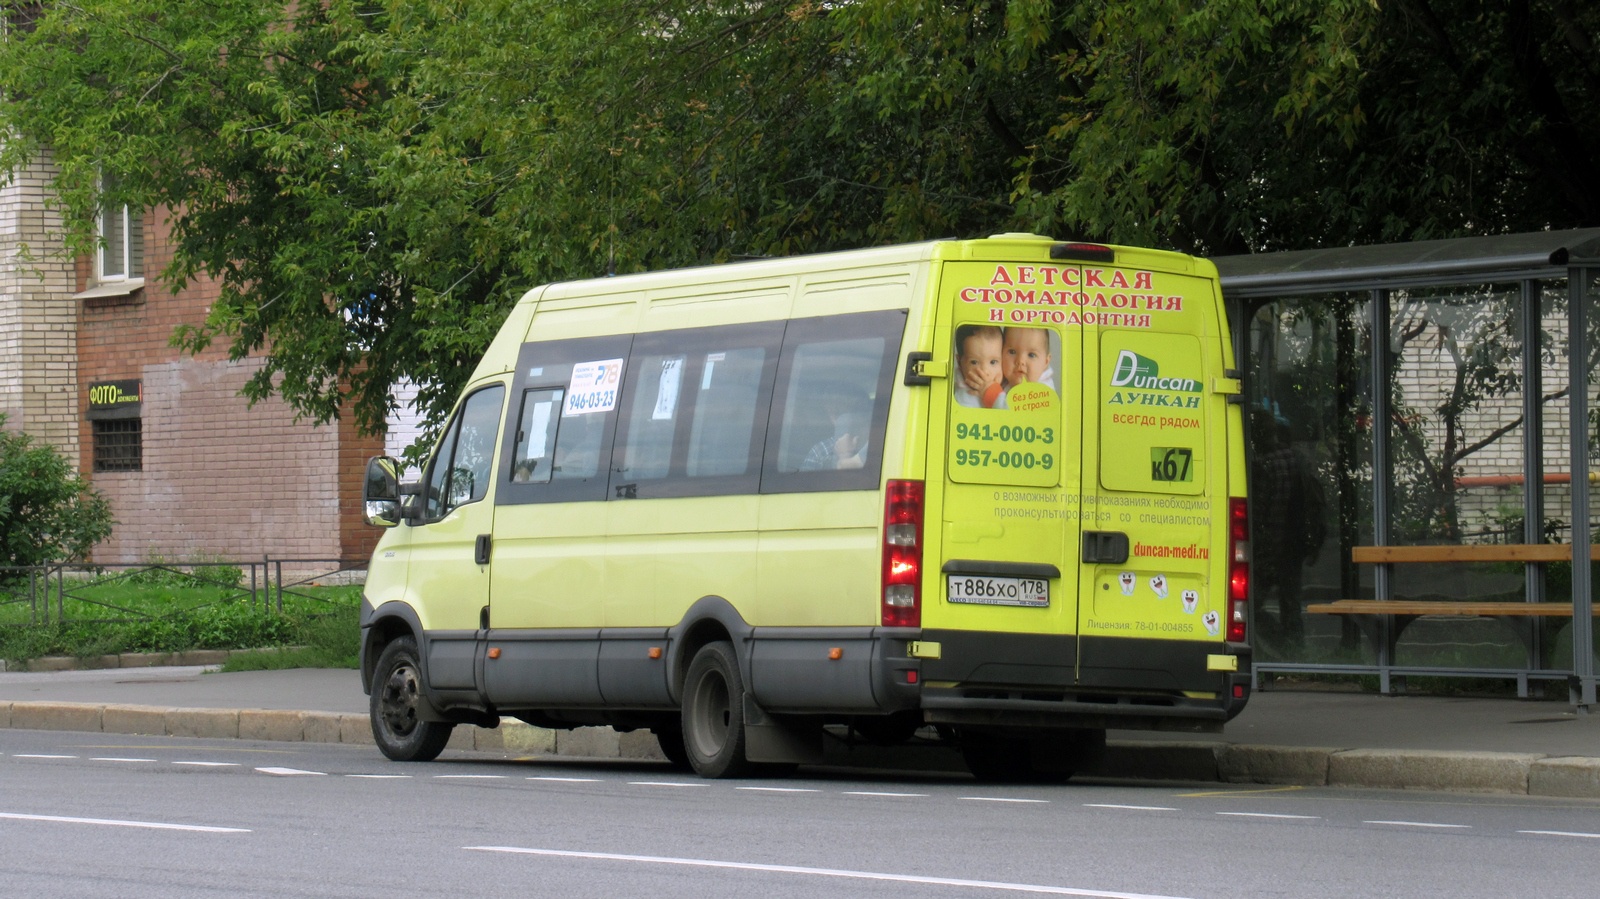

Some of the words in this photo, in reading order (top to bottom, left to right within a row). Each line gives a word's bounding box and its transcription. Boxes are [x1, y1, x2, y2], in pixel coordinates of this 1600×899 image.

[990, 265, 1154, 290] ДЕТСКАЯ
[960, 288, 1183, 311] СТОМАТОЛОГИЯ
[989, 309, 1003, 322] И
[1010, 309, 1152, 328] ОРТОДОНТИЯ
[1110, 349, 1195, 392] Duncan
[90, 385, 116, 404] ФОТО
[570, 390, 614, 410] 946-03-23
[1012, 393, 1026, 402] без
[1028, 391, 1050, 400] боли
[1108, 391, 1201, 409] ДУНКАН
[1022, 401, 1050, 411] страха
[1113, 413, 1156, 427] всегда
[1160, 416, 1200, 430] рядом
[956, 422, 1054, 445] 941-000-3
[955, 448, 1054, 470] 957-000-9
[993, 491, 1000, 501] о
[1002, 491, 1058, 503] возможных
[1153, 496, 1209, 512] необходимо
[994, 507, 1112, 523] проконсультироваться
[1119, 513, 1132, 523] со
[1140, 513, 1209, 526] специалистом
[1134, 542, 1209, 560] duncan-medi.ru
[1020, 580, 1043, 594] 178
[1087, 619, 1132, 630] Лицензия:
[1135, 621, 1194, 632] 78-01-004855
